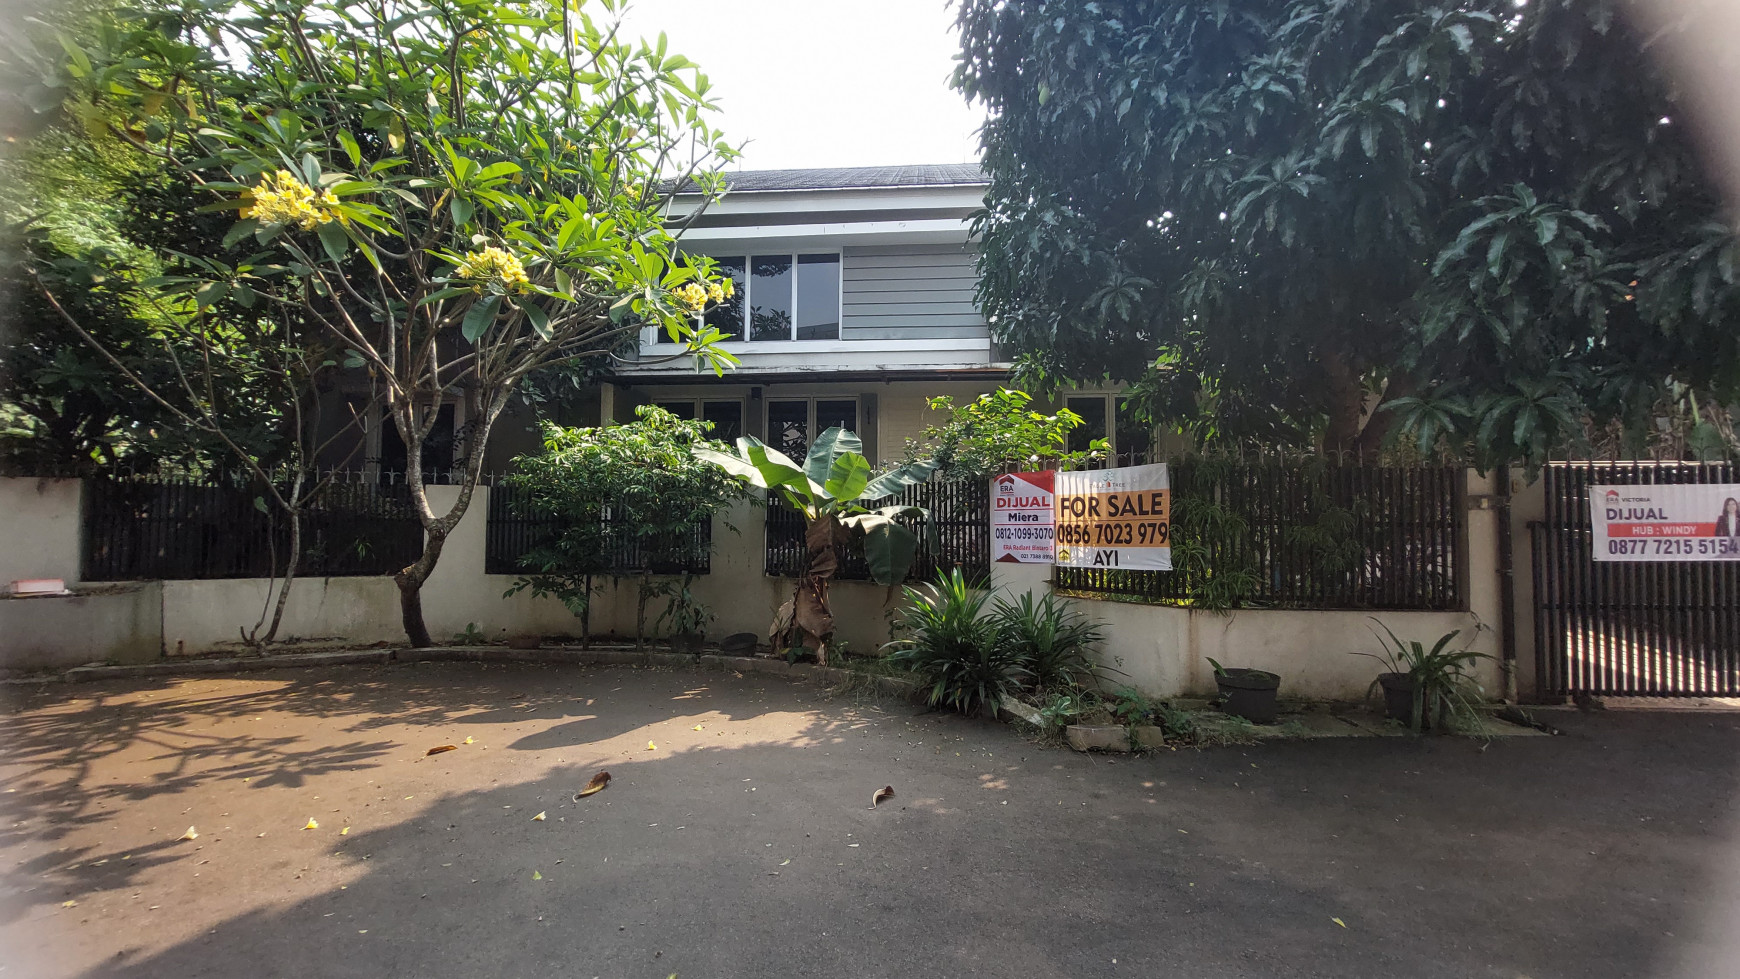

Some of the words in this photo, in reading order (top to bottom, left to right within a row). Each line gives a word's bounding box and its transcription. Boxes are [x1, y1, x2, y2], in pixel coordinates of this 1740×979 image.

[996, 496, 1050, 508] DIJUAL
[1060, 496, 1101, 518] FOR
[1107, 493, 1163, 517] SALE
[1008, 513, 1039, 521] Miera
[1606, 507, 1668, 520] DIJUAL
[995, 527, 1054, 540] 0812-1099-3070
[1057, 523, 1090, 544] 0856
[1094, 522, 1132, 544] 7023
[1137, 522, 1168, 544] 979
[1632, 526, 1654, 535] HUB
[1662, 525, 1697, 535] WINDY
[1608, 539, 1648, 555] 0877
[1652, 539, 1693, 555] 7215
[1698, 539, 1739, 554] 5154
[1093, 549, 1119, 567] AYI
